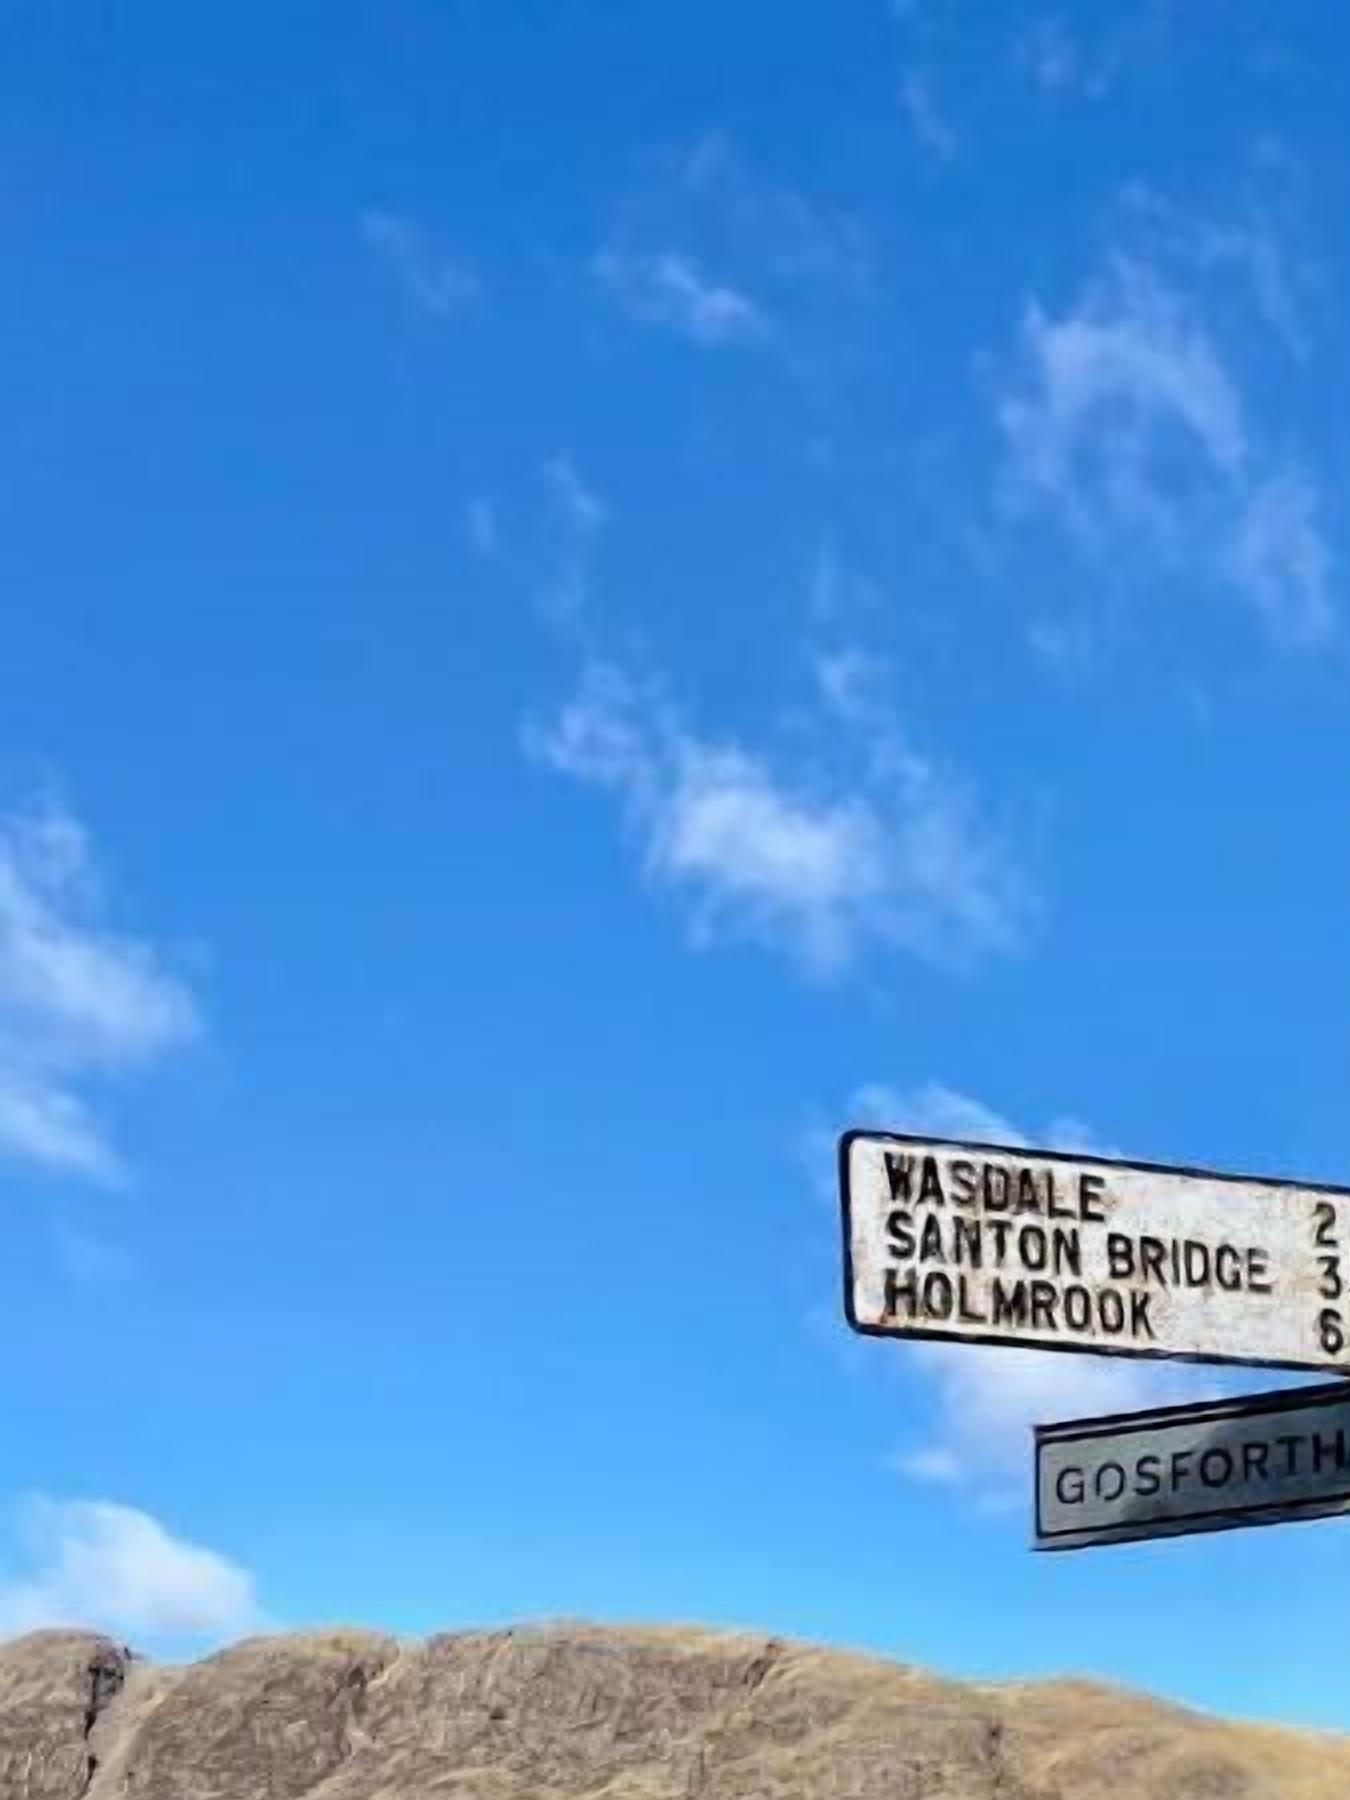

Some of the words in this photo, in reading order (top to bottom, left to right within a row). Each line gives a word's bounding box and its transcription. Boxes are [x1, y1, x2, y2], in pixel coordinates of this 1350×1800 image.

[883, 1152, 1106, 1221] WASDALE
[1312, 1202, 1337, 1248] 2
[885, 1211, 1083, 1277] SANTON
[1107, 1233, 1275, 1294] BRIDGE
[883, 1267, 1156, 1340] HOLMROOK
[1318, 1307, 1345, 1355] 6
[1055, 1428, 1345, 1504] GOSFORTH
